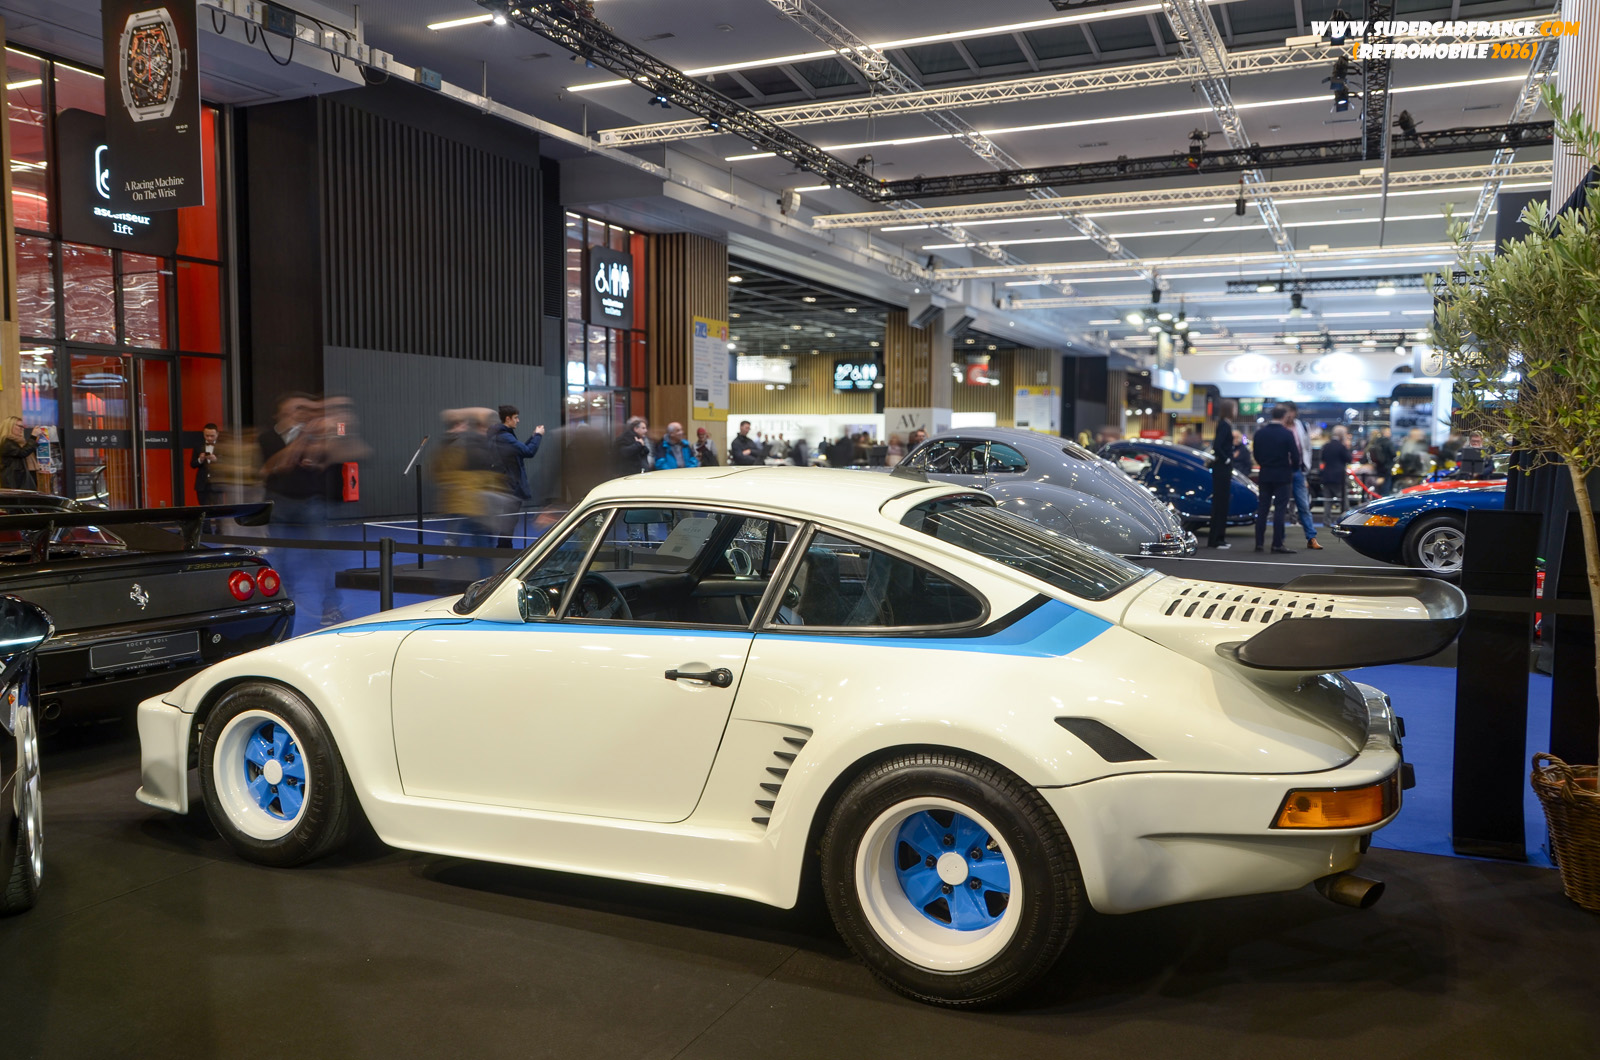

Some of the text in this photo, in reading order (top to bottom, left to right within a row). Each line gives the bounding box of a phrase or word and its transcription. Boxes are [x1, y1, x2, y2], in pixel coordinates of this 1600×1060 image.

[125, 176, 184, 191] A Racing Machine
[132, 188, 176, 201] On The Wrist
[113, 222, 134, 236] lift
